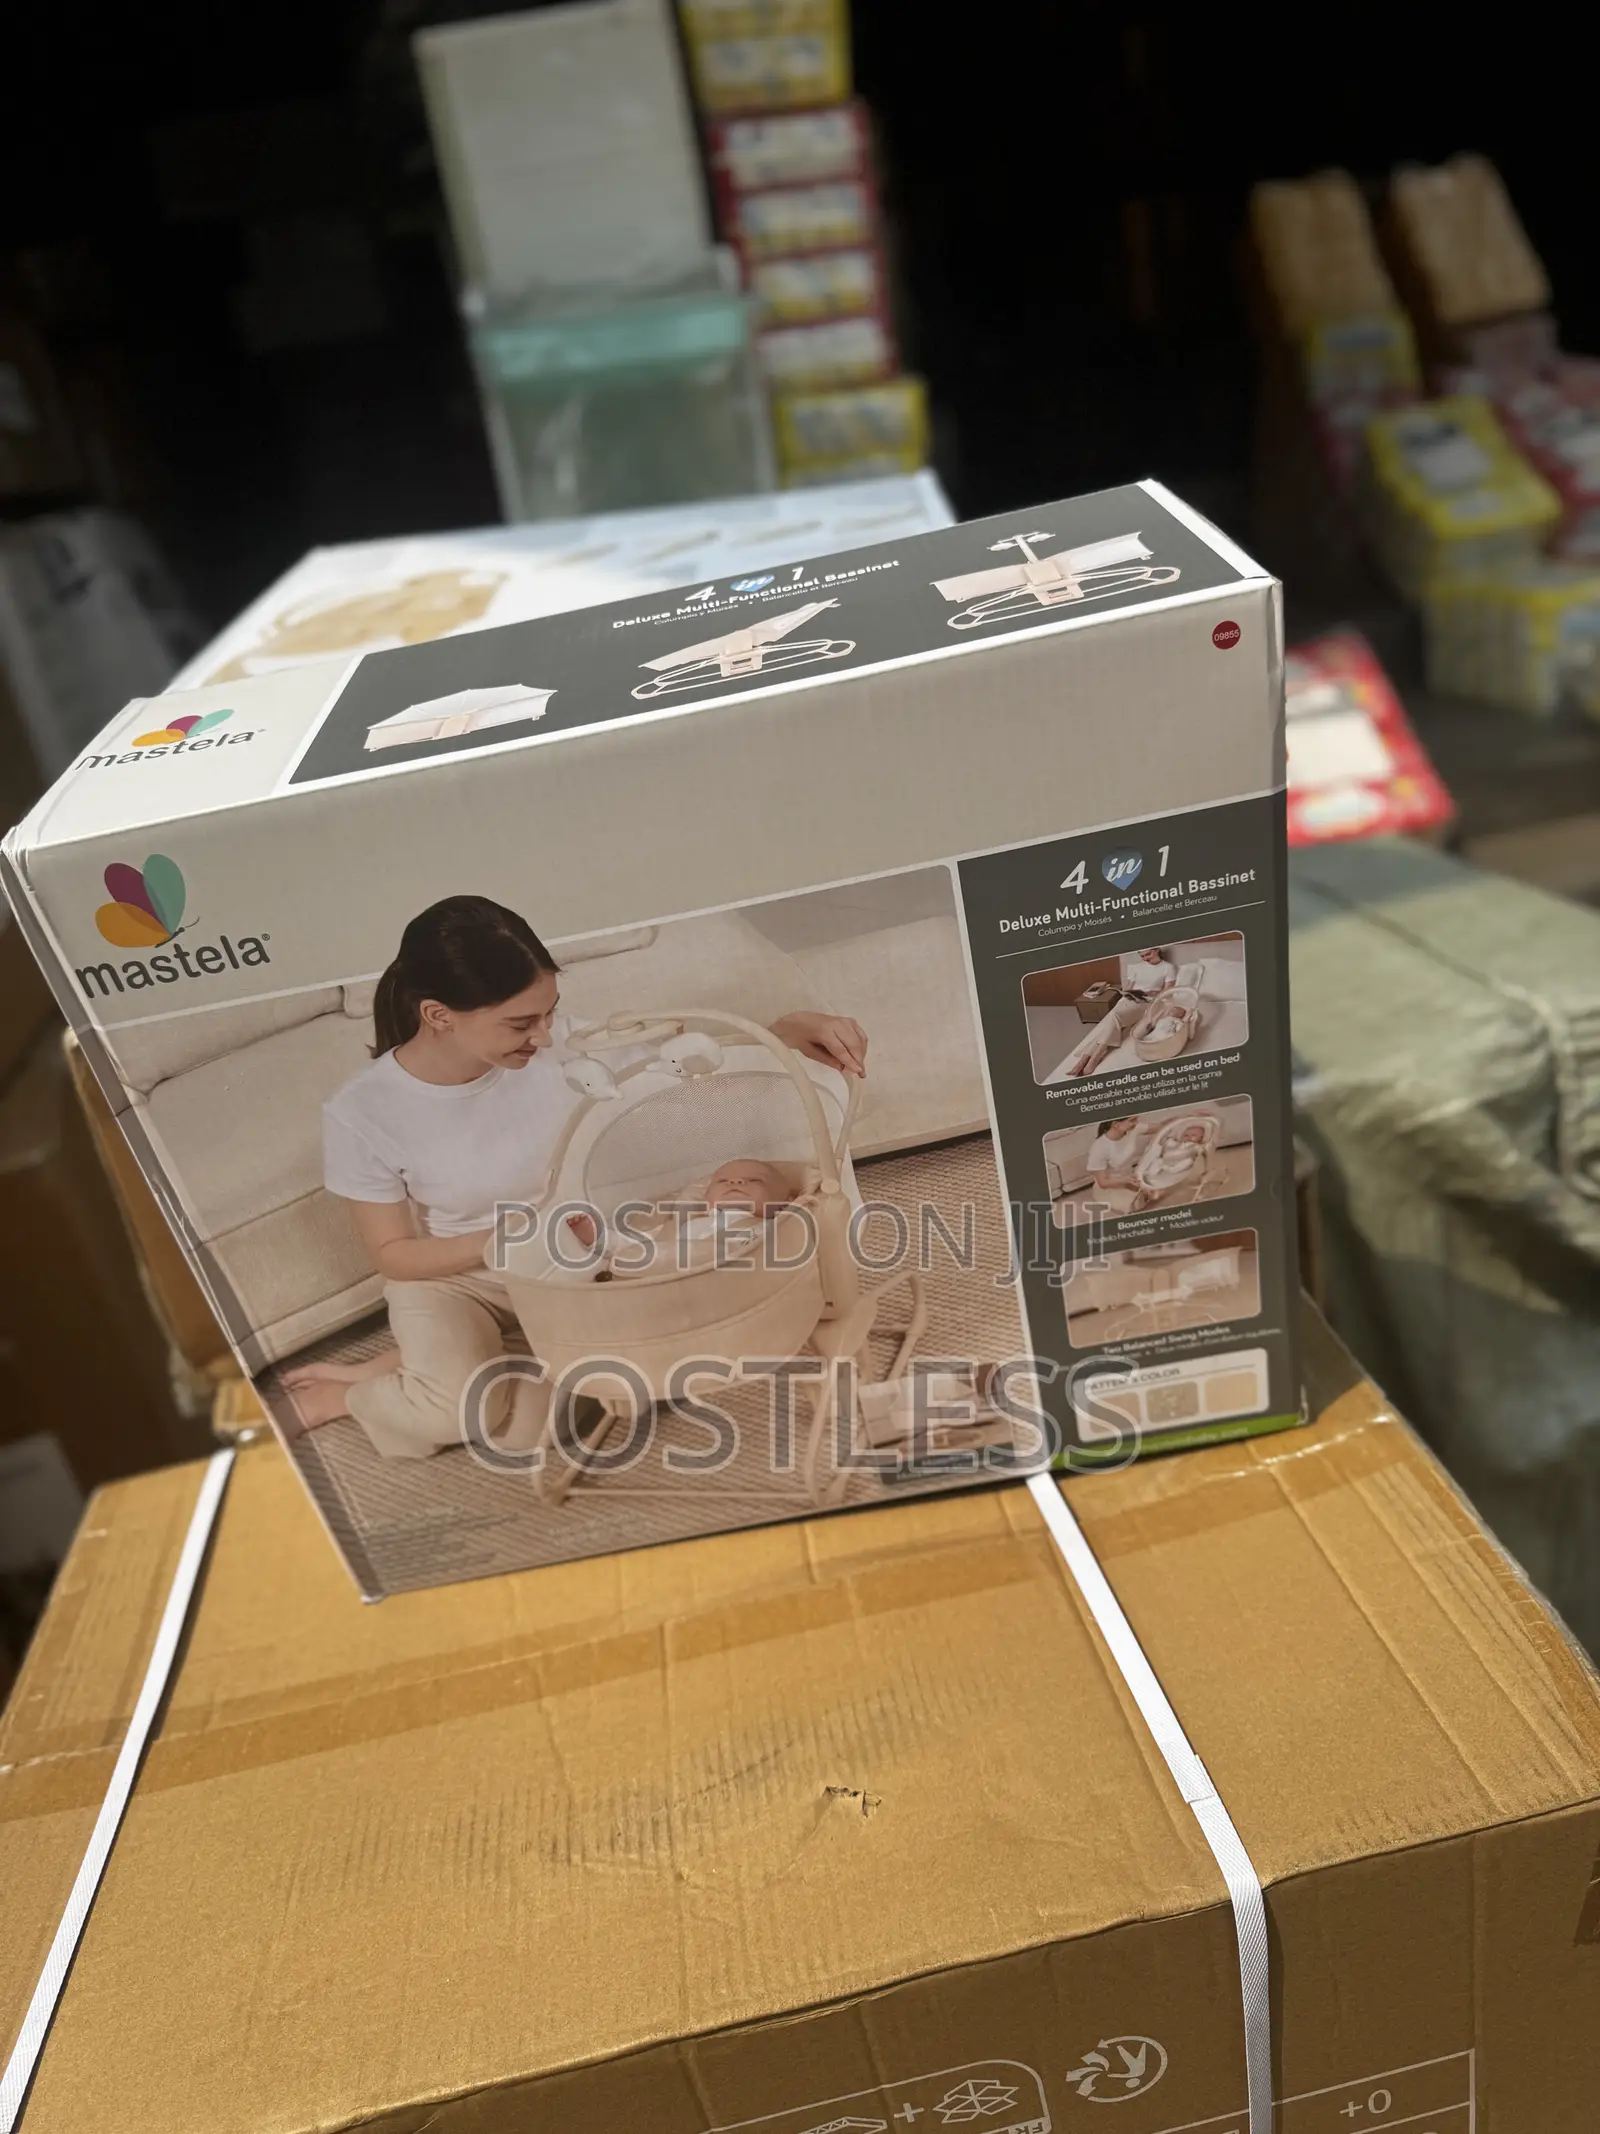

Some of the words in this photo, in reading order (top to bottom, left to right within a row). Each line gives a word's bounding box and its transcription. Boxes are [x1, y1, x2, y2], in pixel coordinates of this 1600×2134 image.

[612, 612, 670, 629] Deluxe
[676, 577, 819, 616] Multi-Functional
[824, 560, 900, 583] Bassinet
[685, 586, 716, 601] 4
[736, 575, 774, 591] in
[792, 566, 803, 581] 1
[1214, 629, 1239, 641] 09855
[1060, 860, 1089, 894] 4
[1105, 856, 1142, 882] in
[1158, 845, 1170, 877] 1
[999, 911, 1051, 933] Deluxe
[1055, 882, 1183, 922] Multi-Functional
[1188, 869, 1256, 894] Bassinet
[1037, 923, 1076, 937] Columpio
[1077, 923, 1084, 931] y
[1084, 915, 1112, 927] Moisés
[1132, 903, 1173, 917] Balancelle
[1175, 901, 1183, 909] et
[1184, 895, 1218, 907] Berceau
[1045, 1080, 1104, 1100] Removable
[1105, 1074, 1138, 1088] cradle
[1139, 1070, 1159, 1081] can
[1161, 1066, 1175, 1076] be
[1177, 1062, 1202, 1074] used
[1204, 1059, 1218, 1068] on
[1219, 1052, 1240, 1065] bed
[1065, 1096, 1088, 1107] Cuna
[1123, 1086, 1140, 1098] que
[1140, 1084, 1151, 1092] se
[1152, 1079, 1175, 1089] utiliza
[1176, 1077, 1188, 1085] en
[1188, 1074, 1197, 1082] la
[1197, 1070, 1223, 1081] cama
[1080, 1101, 1114, 1113] Berceau
[1115, 1093, 1152, 1106] amovible
[1177, 1085, 1191, 1094] sur
[1117, 1216, 1159, 1230] Bouncer
[1160, 1209, 1192, 1223] model
